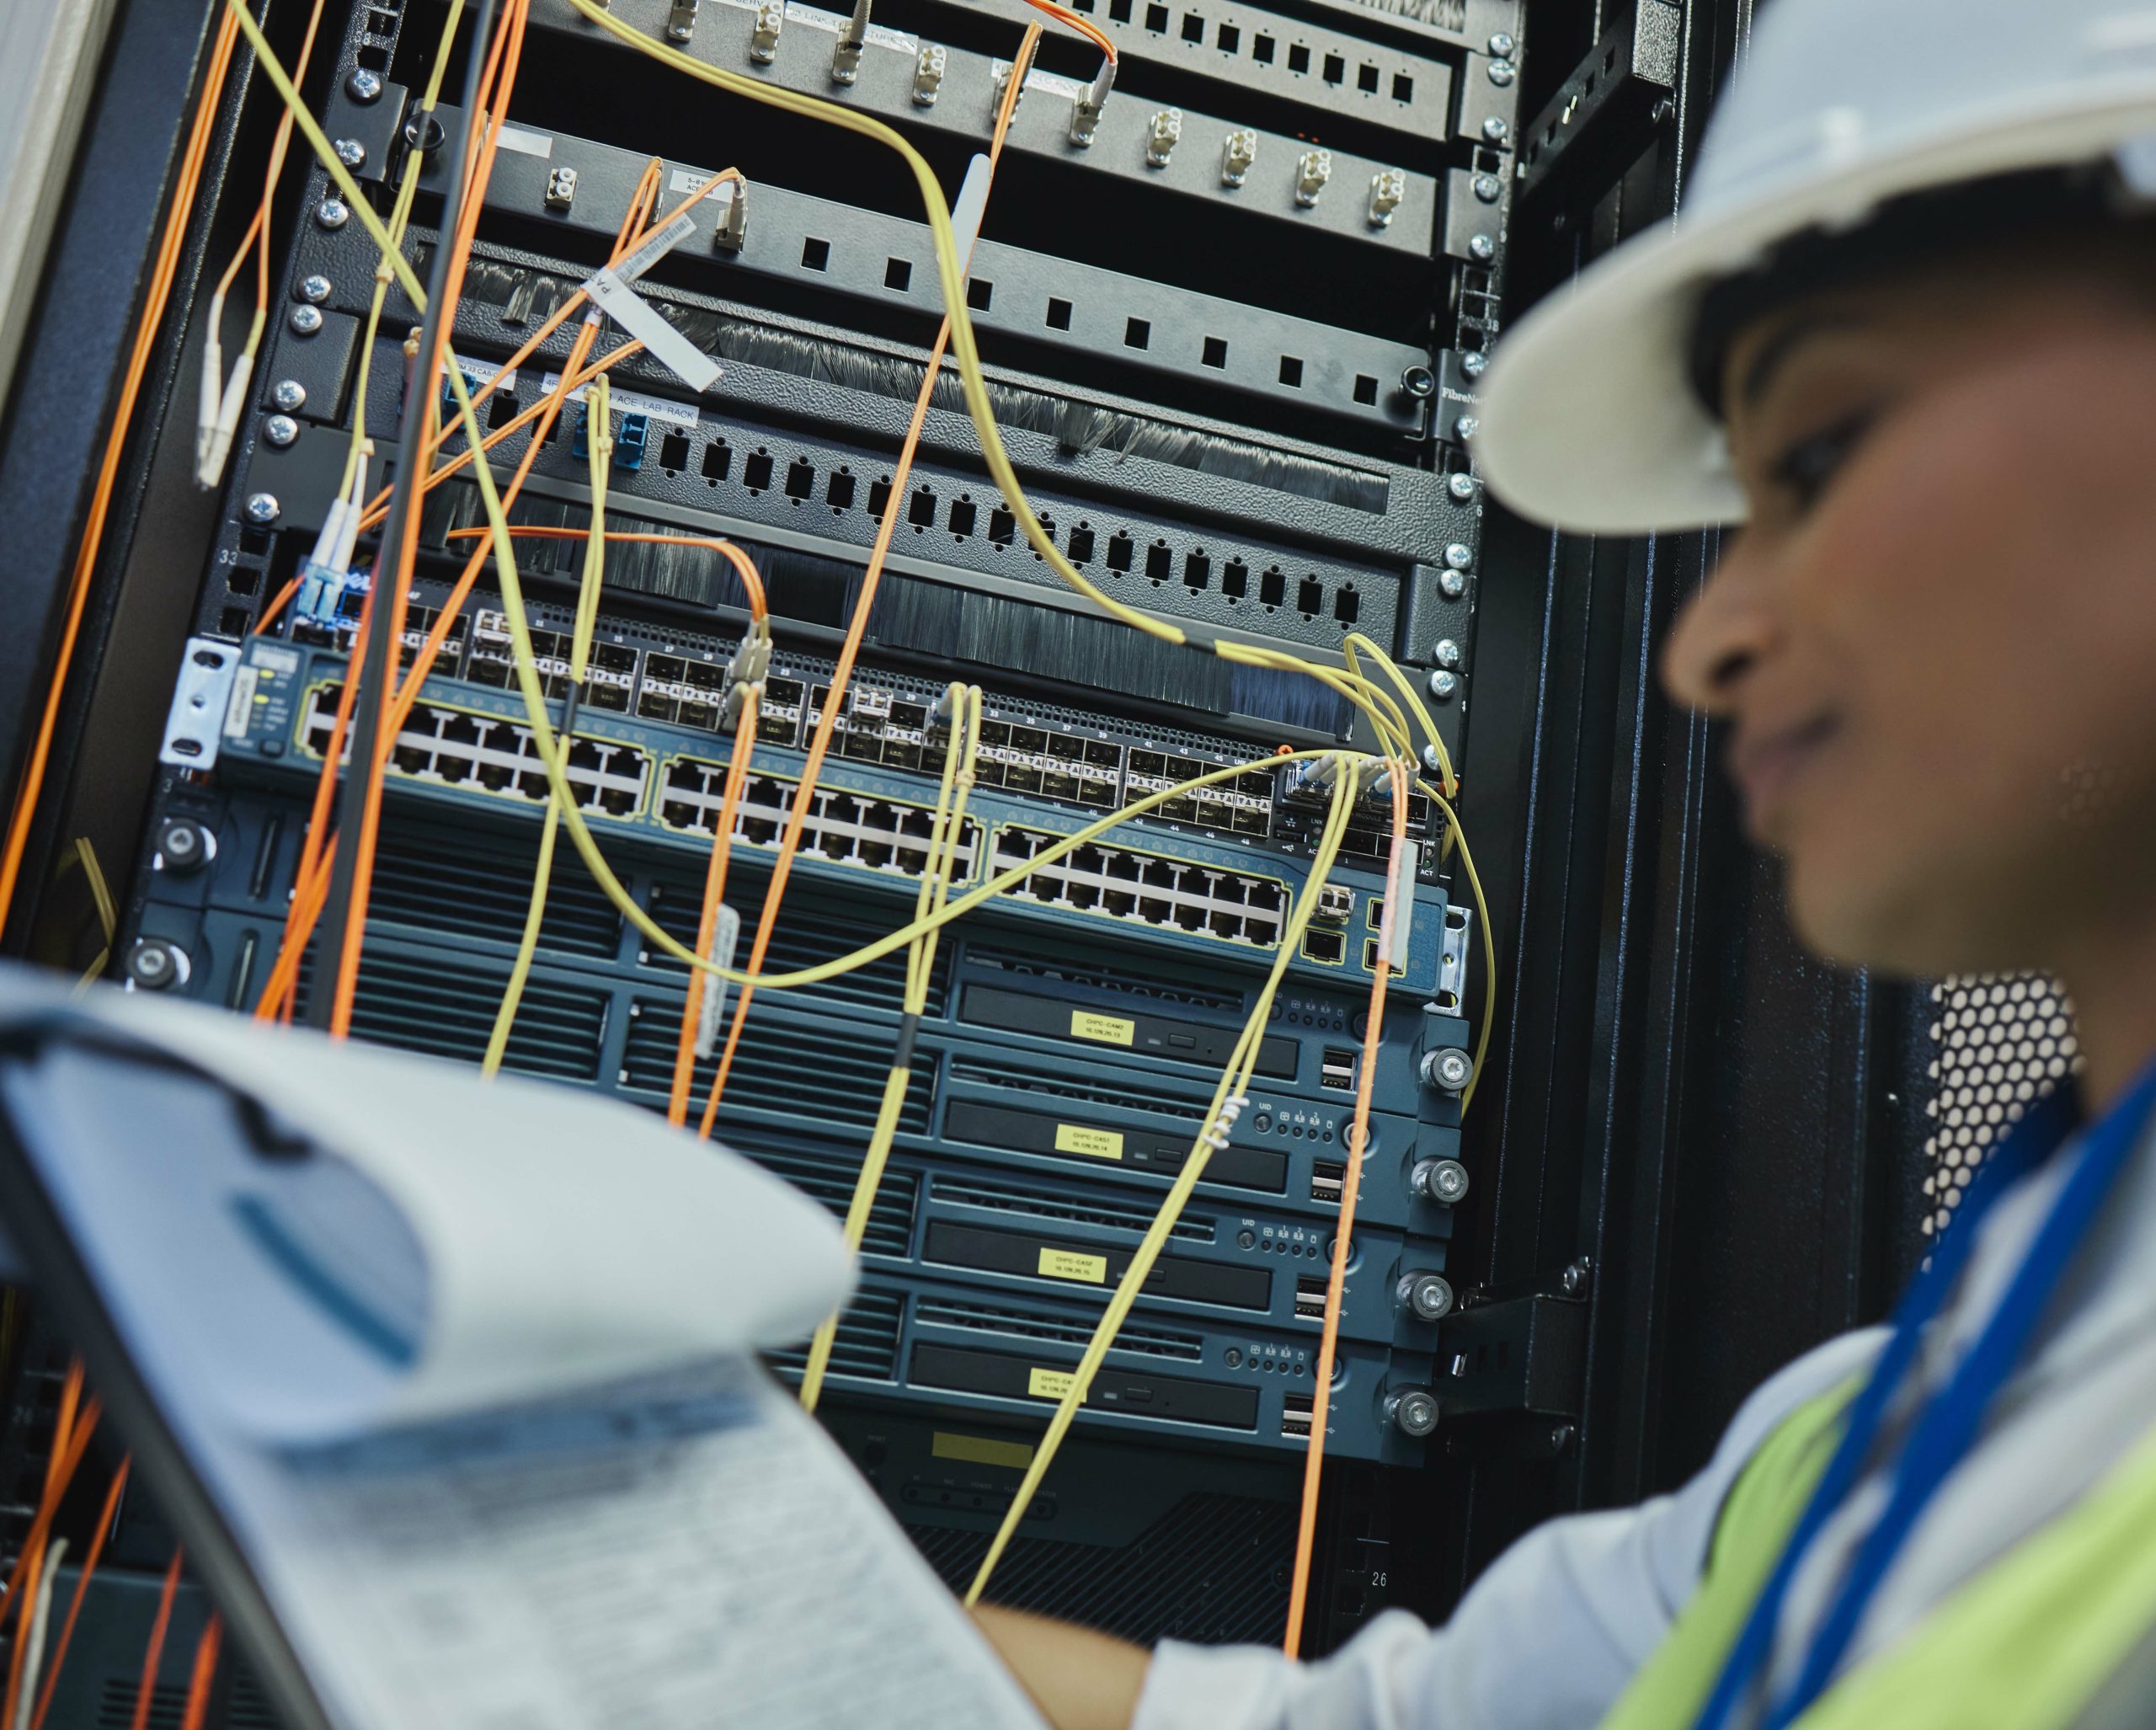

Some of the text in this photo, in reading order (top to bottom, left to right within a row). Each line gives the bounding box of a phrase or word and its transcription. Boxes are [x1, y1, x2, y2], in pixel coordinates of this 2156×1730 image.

[617, 395, 638, 407] ACE
[643, 400, 662, 413] LAB
[667, 406, 695, 420] RACK
[219, 549, 238, 565] 33
[905, 692, 916, 702] 29
[990, 708, 999, 718] 33
[1026, 716, 1035, 725] 35
[1062, 724, 1071, 732] 37
[1097, 730, 1107, 740] 39
[1144, 740, 1153, 749] 41
[1179, 747, 1188, 756] 43
[1214, 754, 1224, 762] 45
[1423, 839, 1436, 847] LNK
[1420, 868, 1433, 877] ACT
[1258, 1102, 1273, 1111] UID
[1241, 1218, 1256, 1227] UID
[1371, 1572, 1387, 1587] 26
